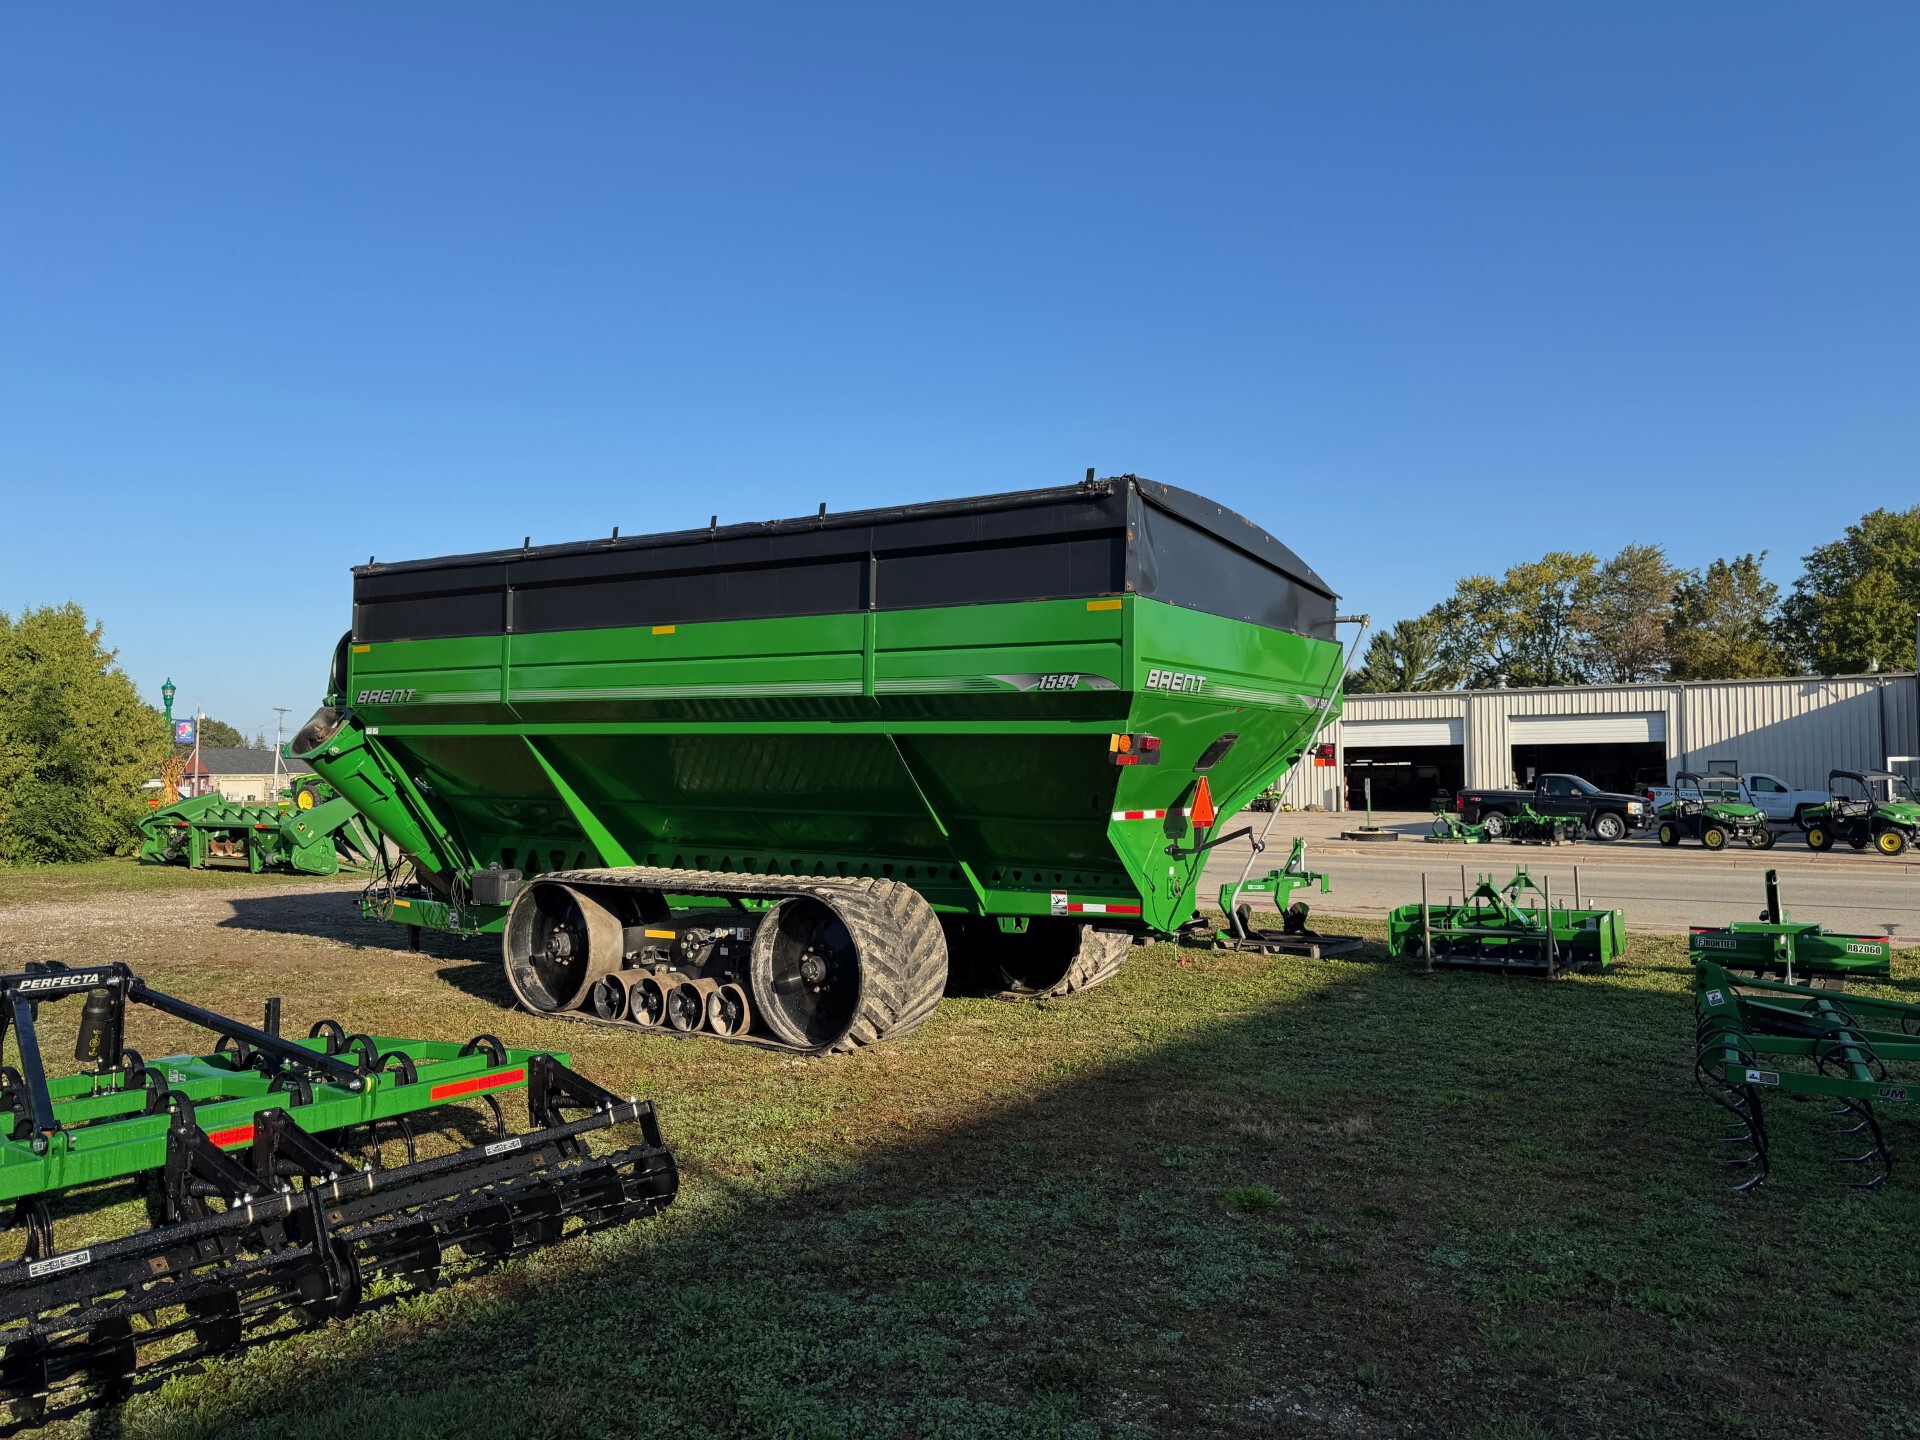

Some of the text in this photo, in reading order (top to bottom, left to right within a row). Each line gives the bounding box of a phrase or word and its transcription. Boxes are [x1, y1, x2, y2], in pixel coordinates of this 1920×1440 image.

[1038, 674, 1080, 690] 1594
[1146, 669, 1207, 693] BRENT
[356, 688, 416, 704] BRENT
[1695, 936, 1736, 949] FRONTIER
[1846, 943, 1882, 955] RB2060
[20, 973, 99, 990] PERFECTA
